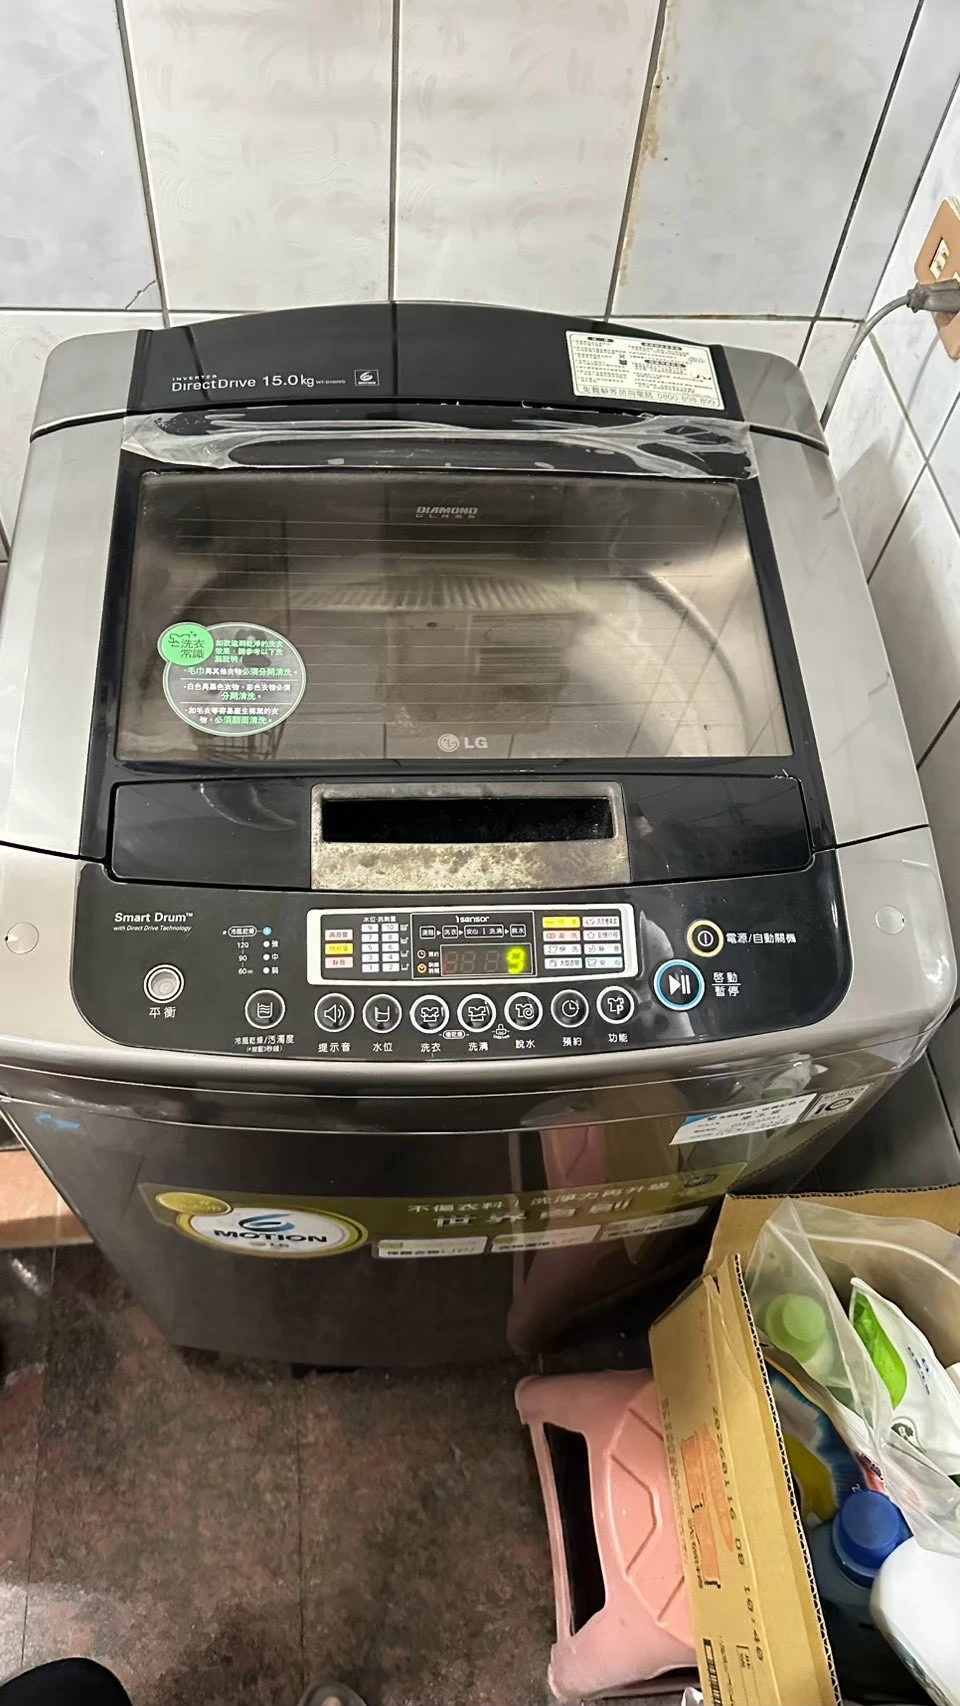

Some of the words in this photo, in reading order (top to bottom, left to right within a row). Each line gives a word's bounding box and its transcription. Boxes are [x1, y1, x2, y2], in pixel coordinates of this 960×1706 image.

[416, 506, 478, 514] DIAMOND
[181, 639, 205, 649] 洗衣
[464, 737, 488, 749] LG
[114, 912, 151, 922] Smart
[237, 941, 249, 949] 120
[507, 947, 525, 975] 9
[715, 986, 740, 997] 暫停
[149, 1006, 176, 1019] 平衡
[562, 1036, 582, 1047] 預約
[608, 1033, 629, 1043] 功能
[318, 1042, 351, 1053] 提示音
[372, 1042, 393, 1052] 水位
[420, 1043, 441, 1053] 洗衣
[213, 1229, 328, 1243] MOTION
